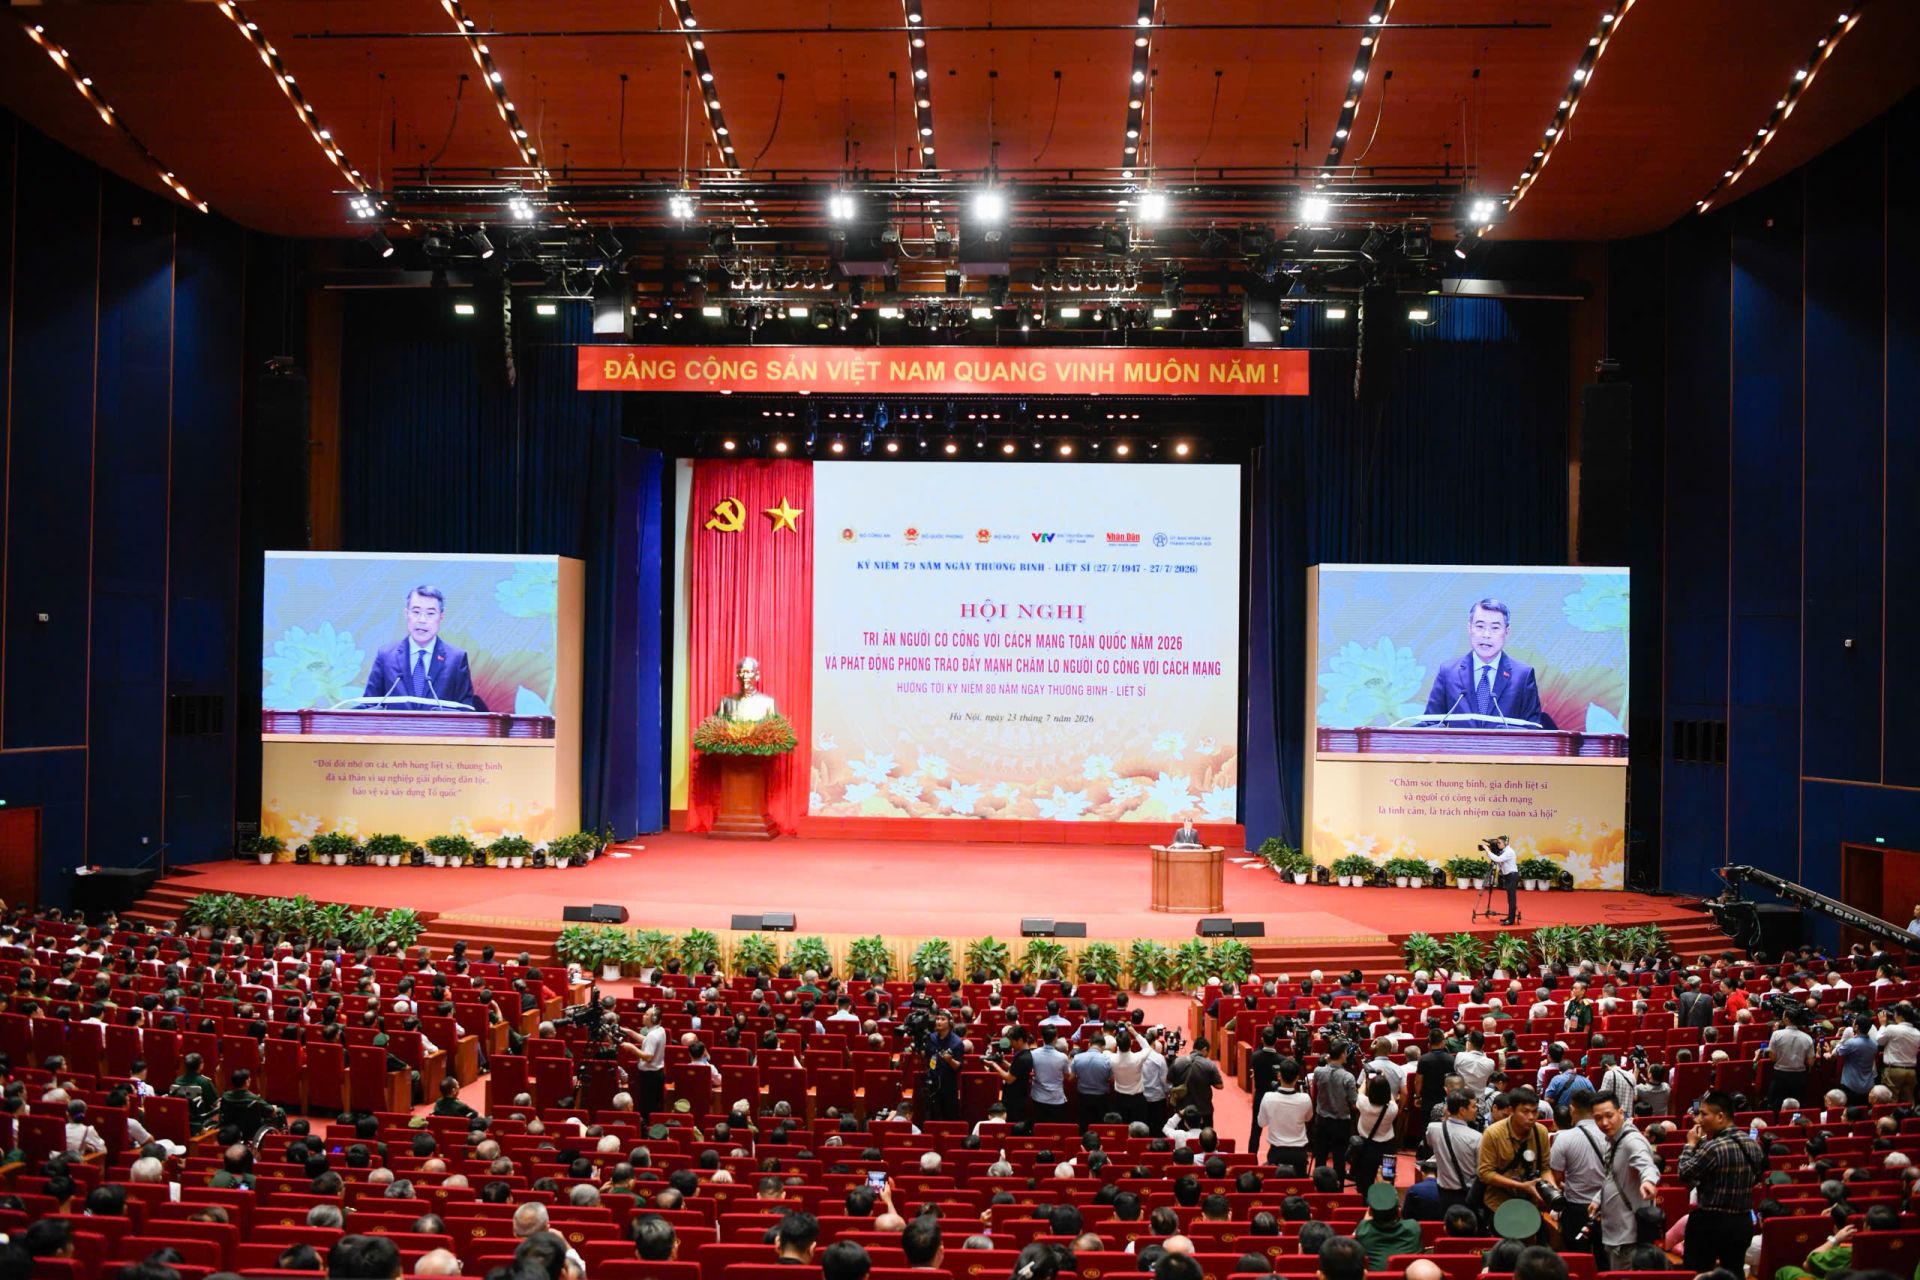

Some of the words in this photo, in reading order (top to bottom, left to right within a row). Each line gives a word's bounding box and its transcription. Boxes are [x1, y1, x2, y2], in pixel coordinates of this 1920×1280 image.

[604, 353, 676, 380] ĐẢNG
[685, 356, 758, 384] CỘNG
[766, 354, 817, 380] SẢN
[826, 357, 881, 385] VIỆT
[890, 361, 945, 380] NAM
[954, 361, 1047, 382] QUANG
[1055, 362, 1114, 383] VINH
[1124, 358, 1200, 383] MUÔN
[1210, 359, 1265, 383] NĂM
[1273, 364, 1279, 383] !
[1032, 532, 1055, 543] VTV
[1106, 532, 1125, 541] Nhân
[1126, 532, 1140, 541] Dân
[904, 562, 915, 570] 79
[1020, 562, 1045, 572] BINH
[960, 599, 1008, 622] HỘI
[1018, 604, 1086, 623] NGHỊ
[864, 632, 879, 646] TRI
[1158, 636, 1183, 650] 2026
[898, 656, 931, 671] PHONG
[1048, 660, 1060, 673] LO
[986, 683, 997, 694] 80
[1086, 684, 1108, 696] BINH
[1007, 714, 1017, 722] 23
[1046, 714, 1051, 722] 7
[1074, 714, 1094, 723] 2026
[1490, 780, 1502, 791] gia
